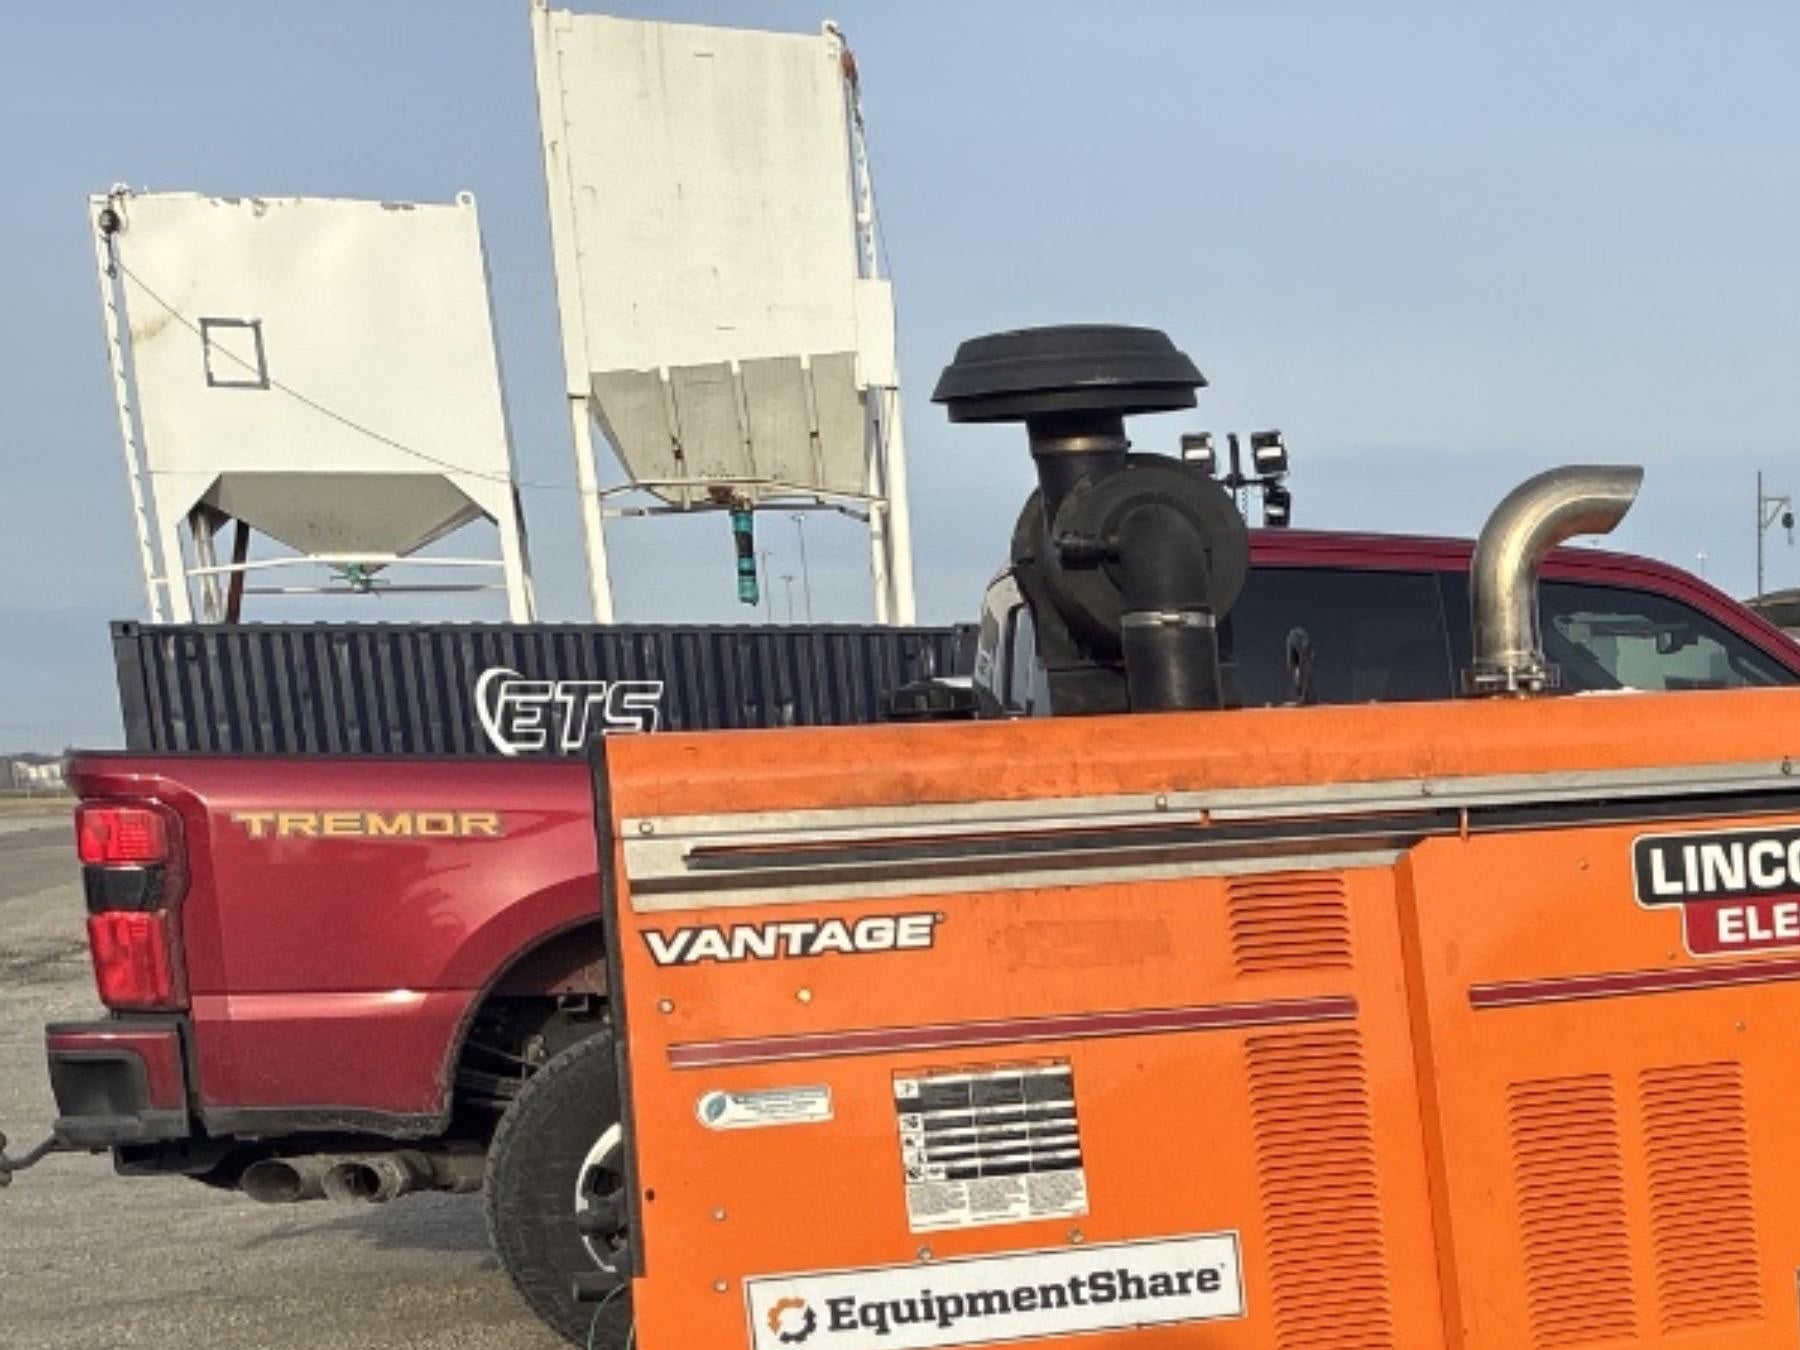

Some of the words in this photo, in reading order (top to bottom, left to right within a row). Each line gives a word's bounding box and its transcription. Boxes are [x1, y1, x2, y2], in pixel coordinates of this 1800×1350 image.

[495, 680, 664, 750] ETS
[231, 810, 504, 839] TREMOR
[641, 913, 937, 966] VANTAGE
[826, 1264, 1222, 1336] EquipmentShare
